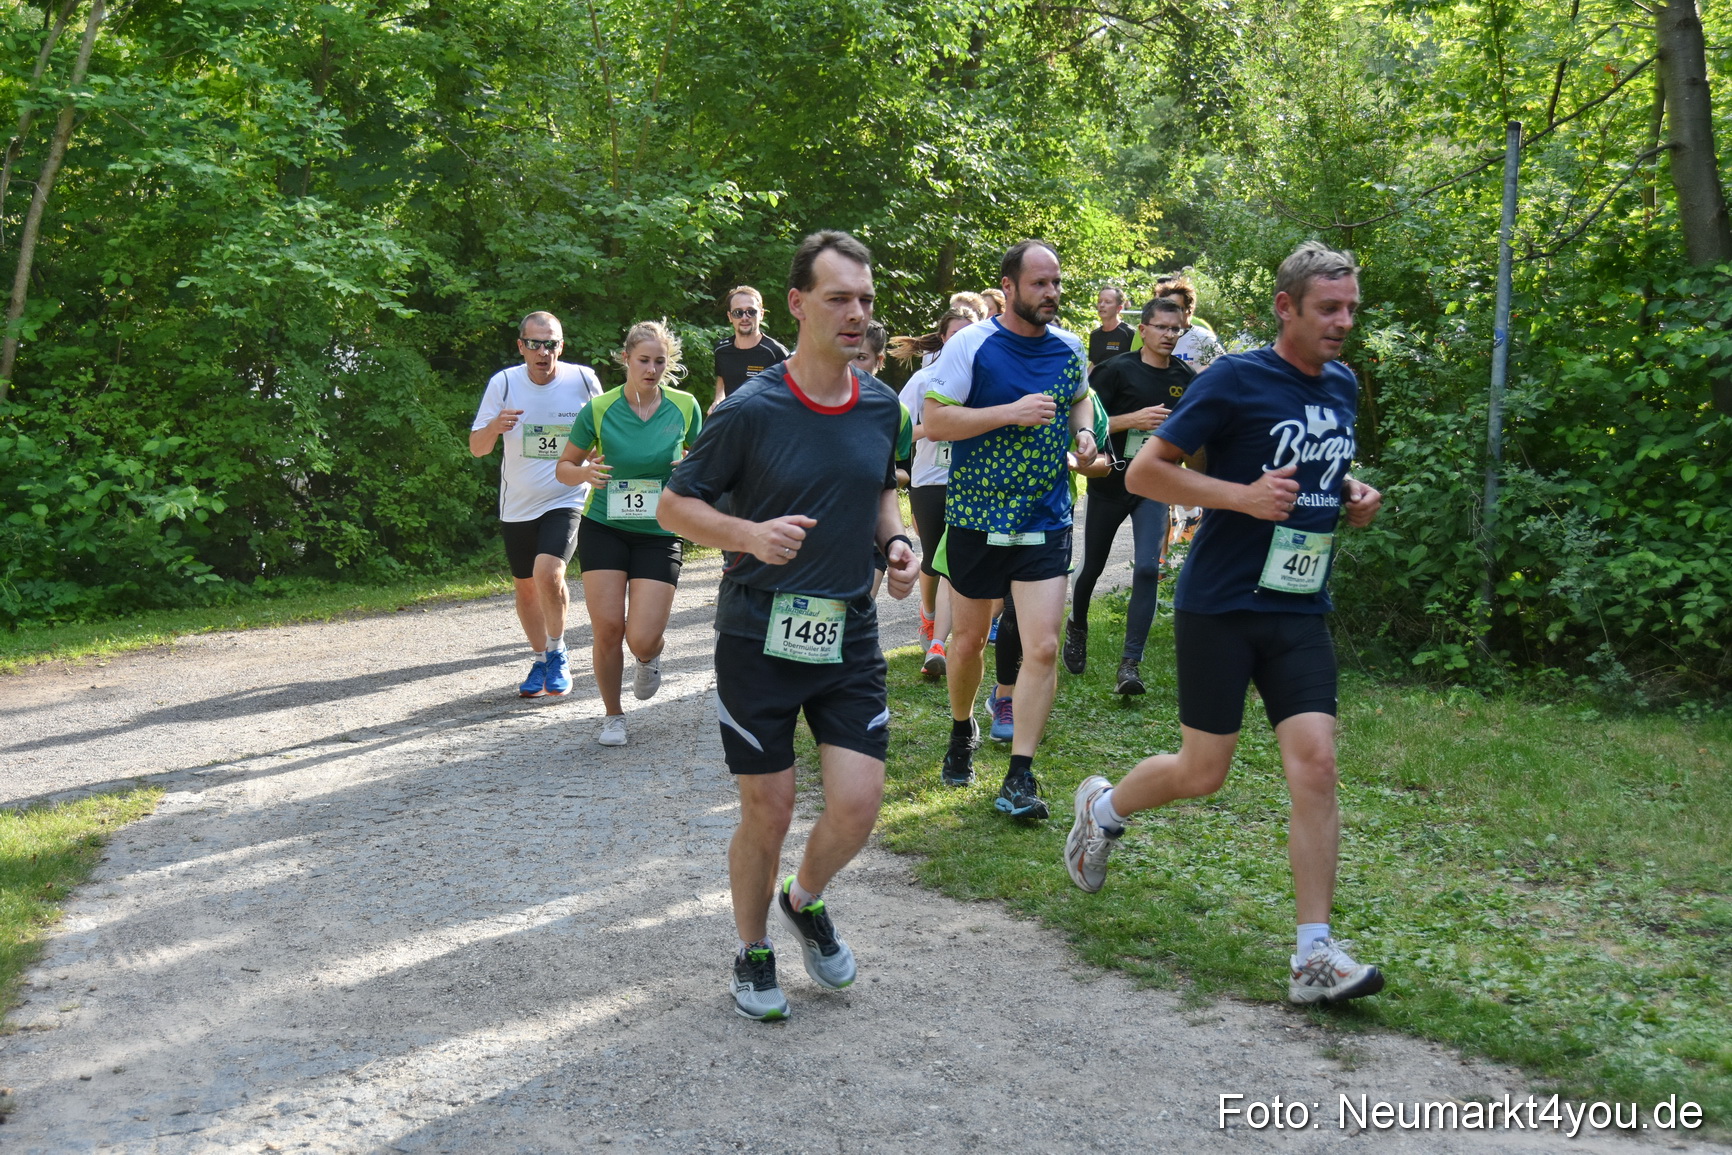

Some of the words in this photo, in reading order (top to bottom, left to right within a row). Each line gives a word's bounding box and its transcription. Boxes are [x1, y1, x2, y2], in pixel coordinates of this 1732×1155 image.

[538, 437, 558, 450] 34
[624, 493, 644, 508] 13
[1283, 553, 1320, 576] 401
[781, 616, 839, 645] 1485
[783, 640, 819, 652] Obermüller
